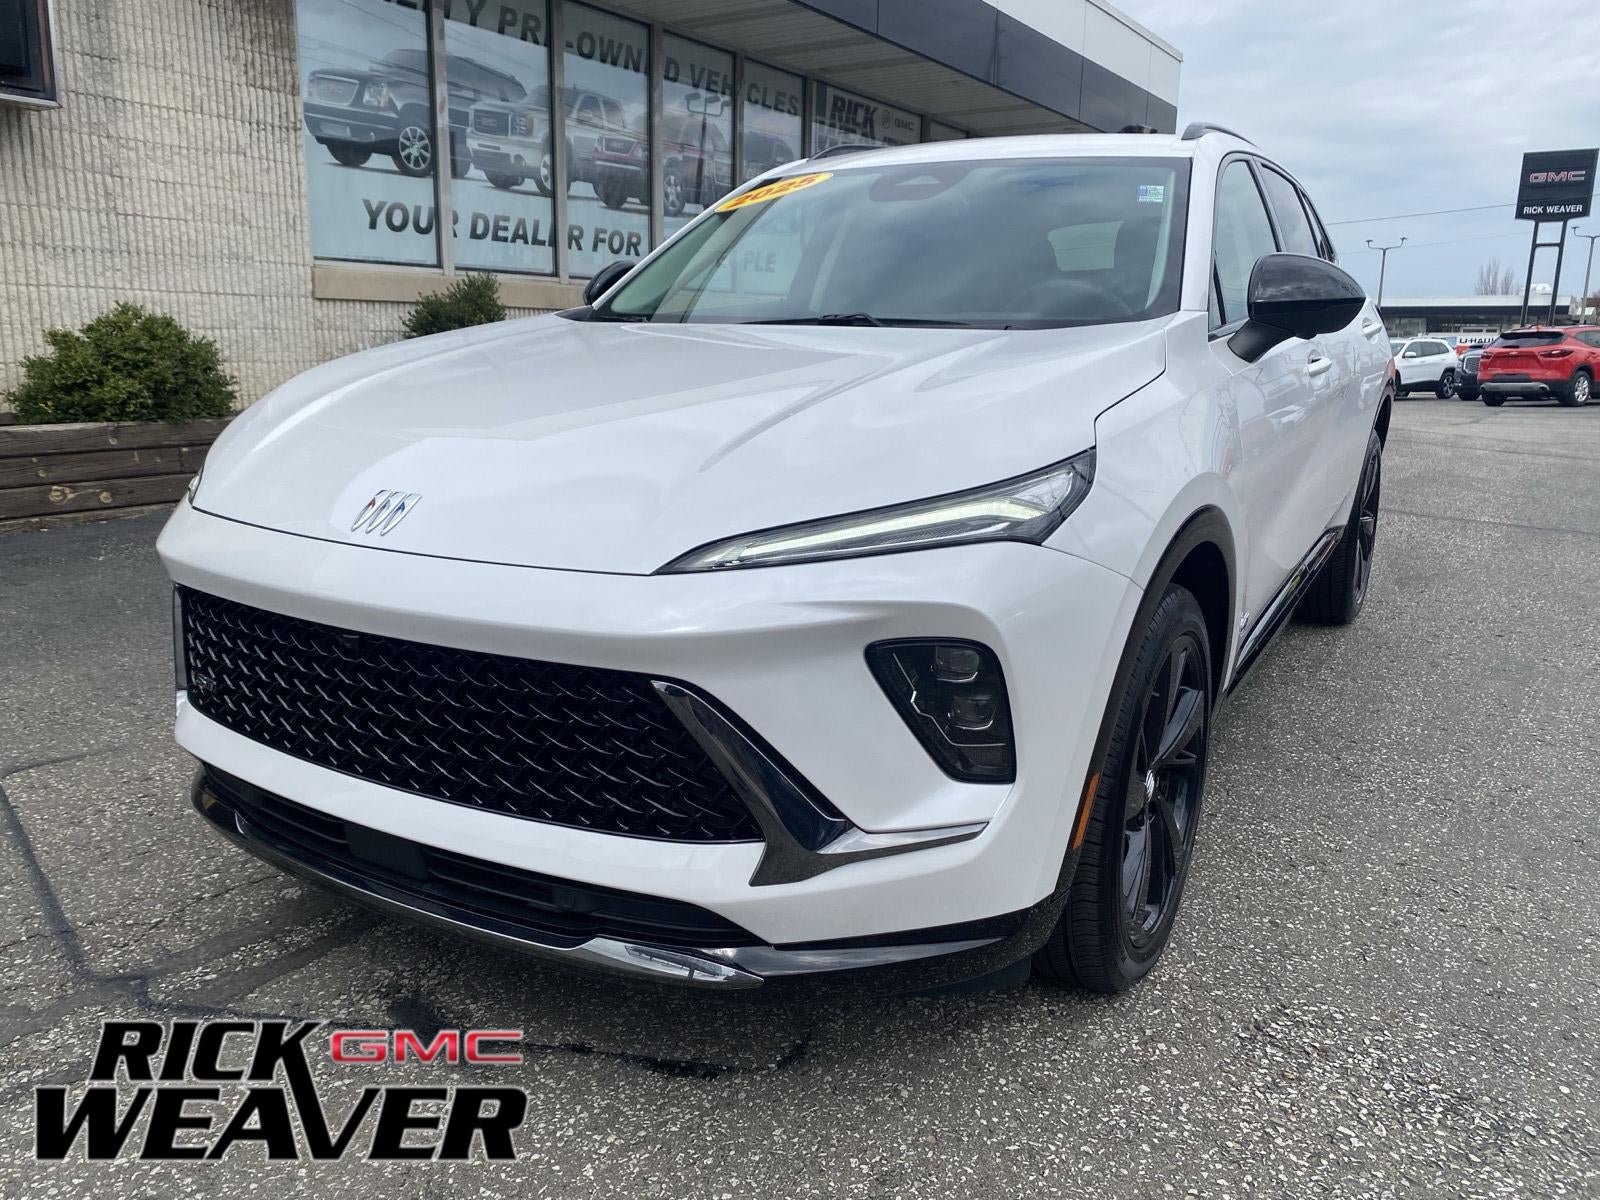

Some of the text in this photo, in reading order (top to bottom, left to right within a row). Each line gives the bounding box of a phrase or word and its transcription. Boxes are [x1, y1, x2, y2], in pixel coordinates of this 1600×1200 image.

[496, 5, 681, 82] PR-OWND
[689, 63, 799, 116] VEHCLES
[831, 95, 879, 140] RICK
[1529, 170, 1586, 183] GMC
[1523, 204, 1583, 215] RICK WEAVER
[468, 211, 585, 252] DEALR
[591, 224, 643, 257] FOR
